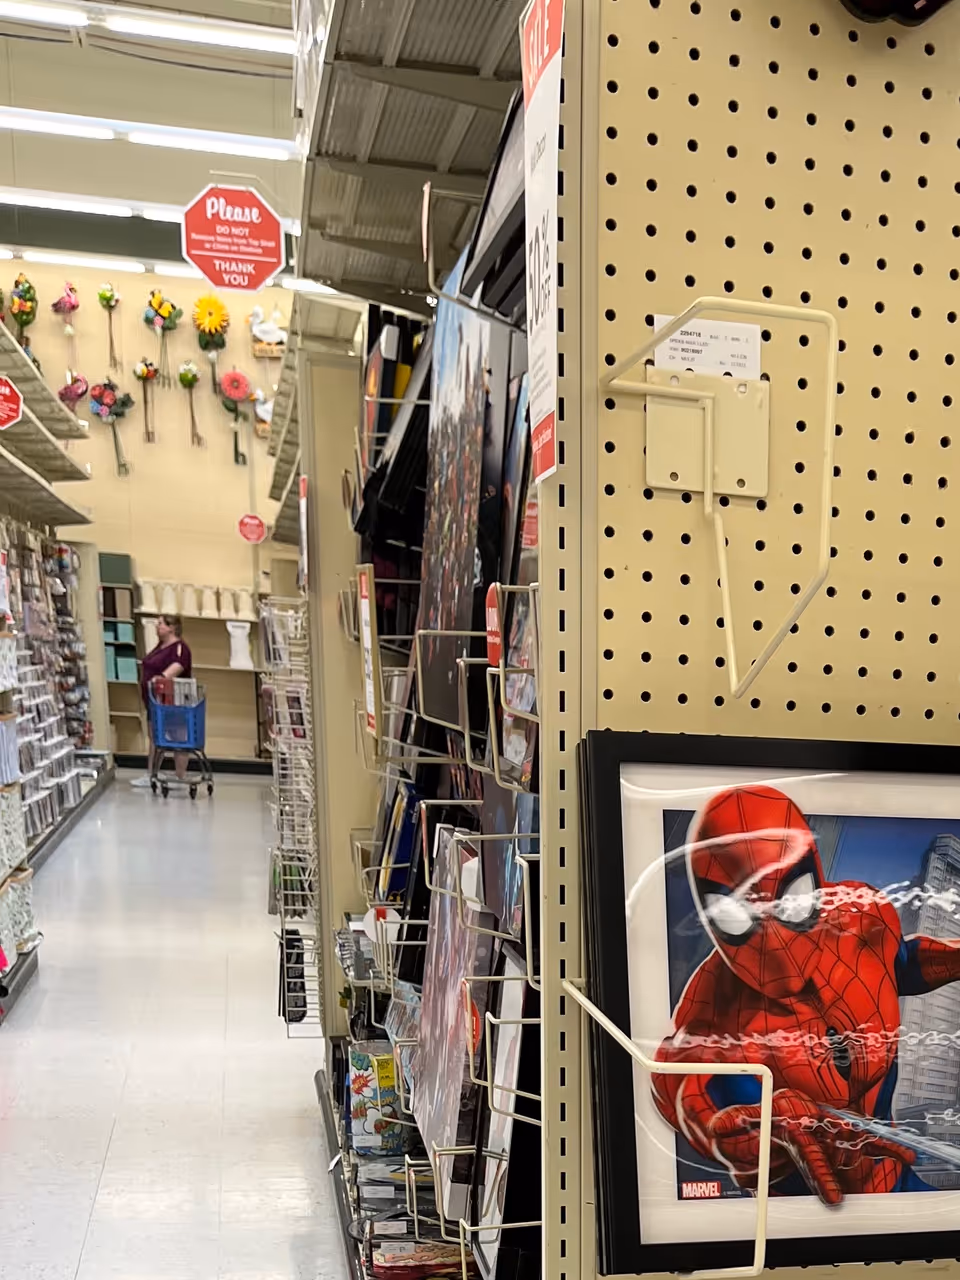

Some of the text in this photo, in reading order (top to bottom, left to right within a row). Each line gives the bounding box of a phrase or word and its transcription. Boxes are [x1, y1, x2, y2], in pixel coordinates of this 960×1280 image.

[205, 196, 262, 224] Please
[215, 225, 250, 237] DO NOT
[213, 259, 256, 275] THANK
[222, 273, 249, 287] YOU
[682, 1181, 720, 1198] MARVEL
